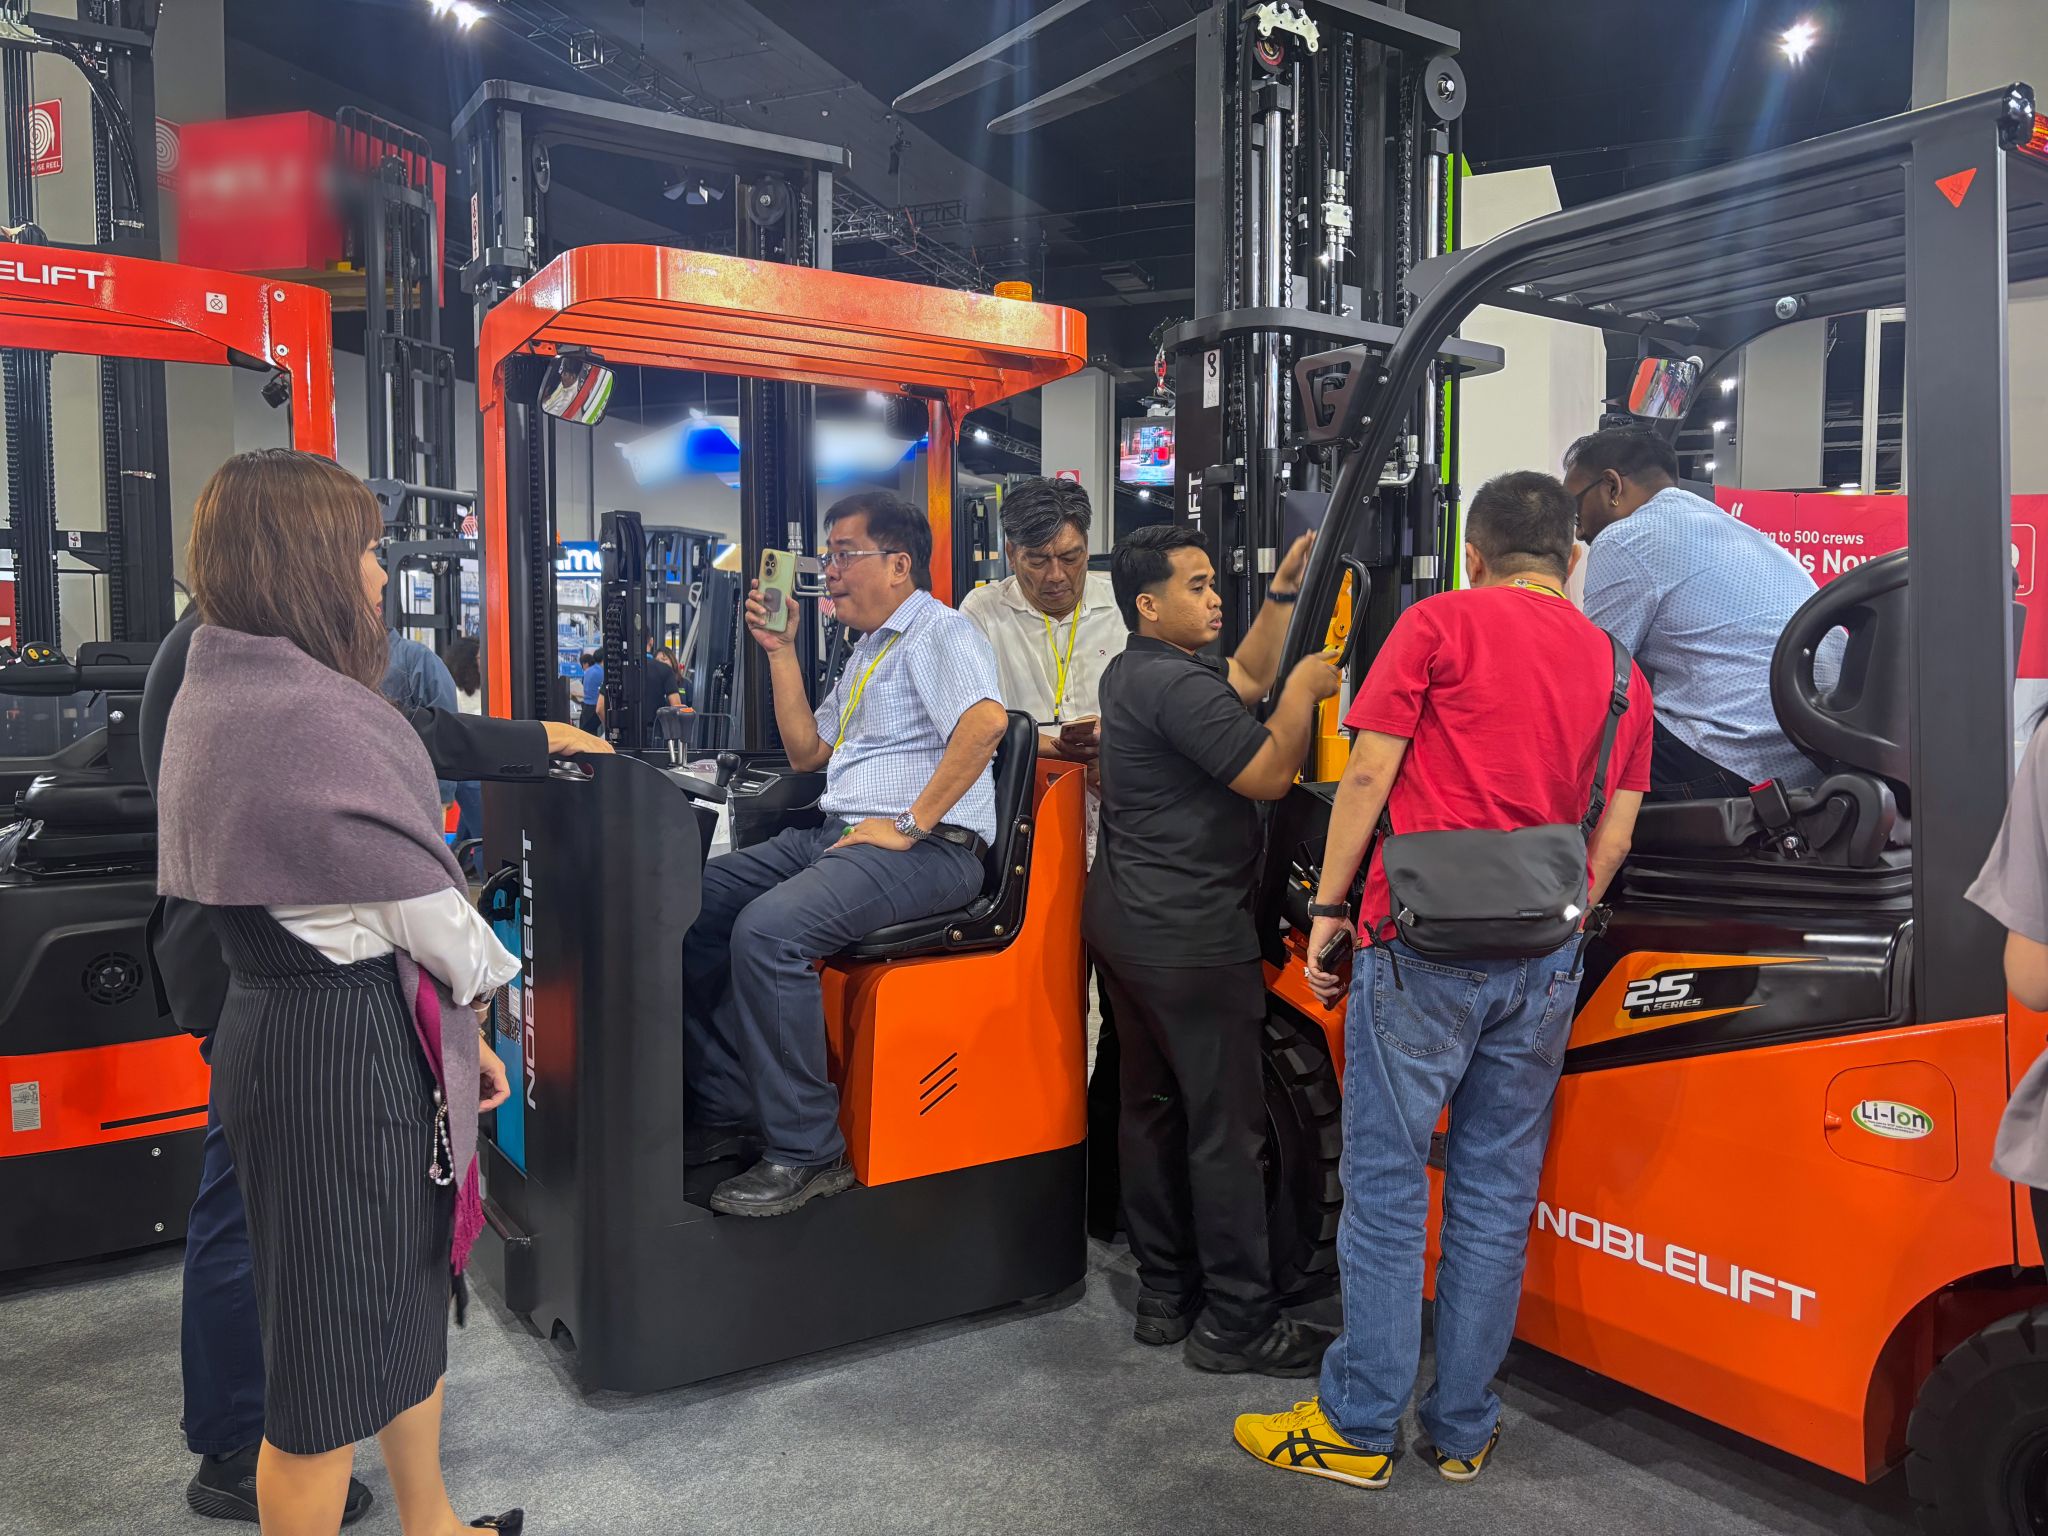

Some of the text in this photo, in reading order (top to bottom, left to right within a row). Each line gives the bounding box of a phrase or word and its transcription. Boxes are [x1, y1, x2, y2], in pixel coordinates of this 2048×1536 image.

[1779, 530, 1791, 542] to
[1794, 530, 1819, 544] 500
[1822, 534, 1864, 545] crews
[522, 829, 536, 1110] NOBLELIFT
[1623, 973, 1694, 1008] 25
[1642, 997, 1702, 1013] A SERIES
[1861, 1101, 1926, 1129] Li-Ion
[1537, 1201, 1816, 1321] NOBLELIFT
